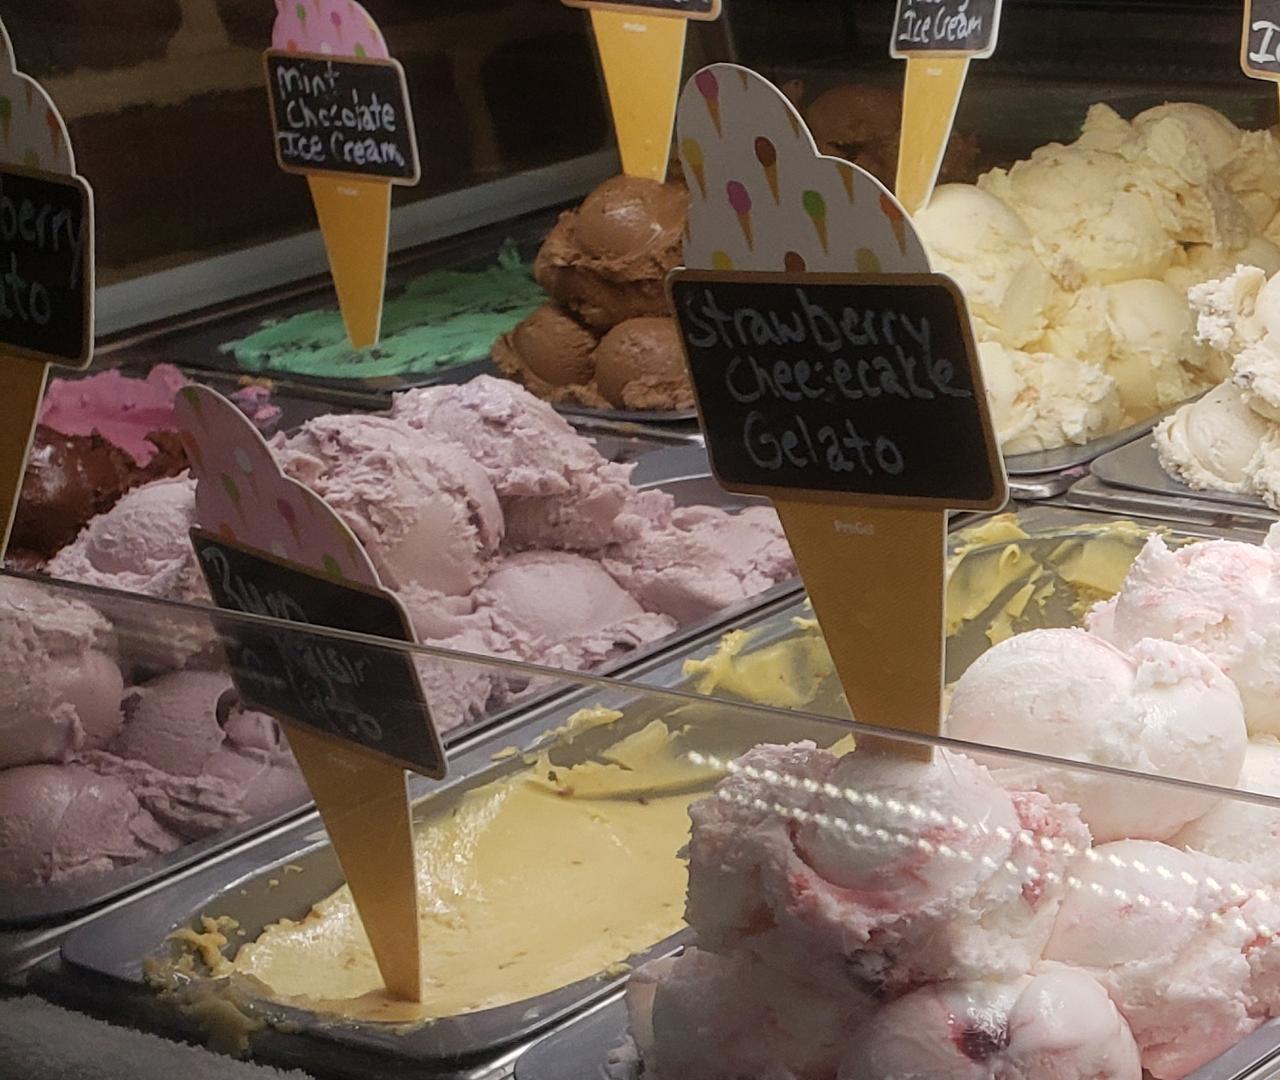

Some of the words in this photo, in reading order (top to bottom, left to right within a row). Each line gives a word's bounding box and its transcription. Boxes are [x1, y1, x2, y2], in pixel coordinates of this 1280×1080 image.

[898, 9, 929, 43] Ice
[934, 6, 982, 41] Cream
[276, 61, 340, 99] Mint
[277, 131, 326, 162] Ice
[330, 131, 404, 167] Cream
[743, 411, 904, 475] Gelato
